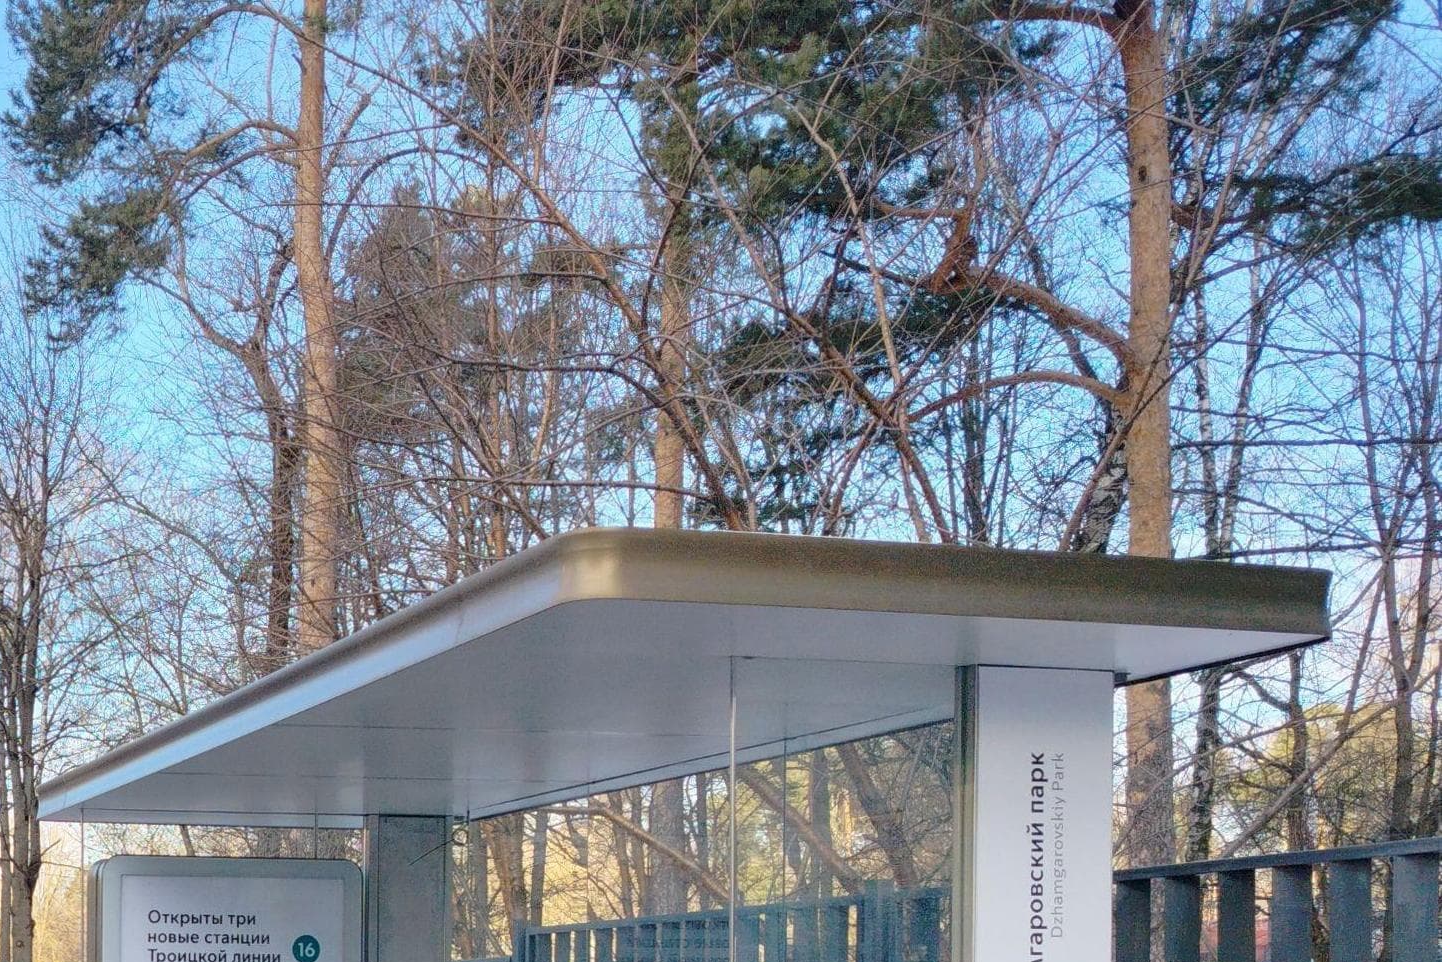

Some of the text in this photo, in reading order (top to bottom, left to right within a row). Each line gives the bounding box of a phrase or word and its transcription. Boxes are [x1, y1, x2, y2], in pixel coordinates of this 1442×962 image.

[1030, 752, 1048, 813] парк
[1051, 753, 1066, 938] Dzhamgarovskiy Park
[148, 910, 256, 928] Открыты три
[148, 932, 270, 946] новые станции
[297, 942, 315, 958] 16
